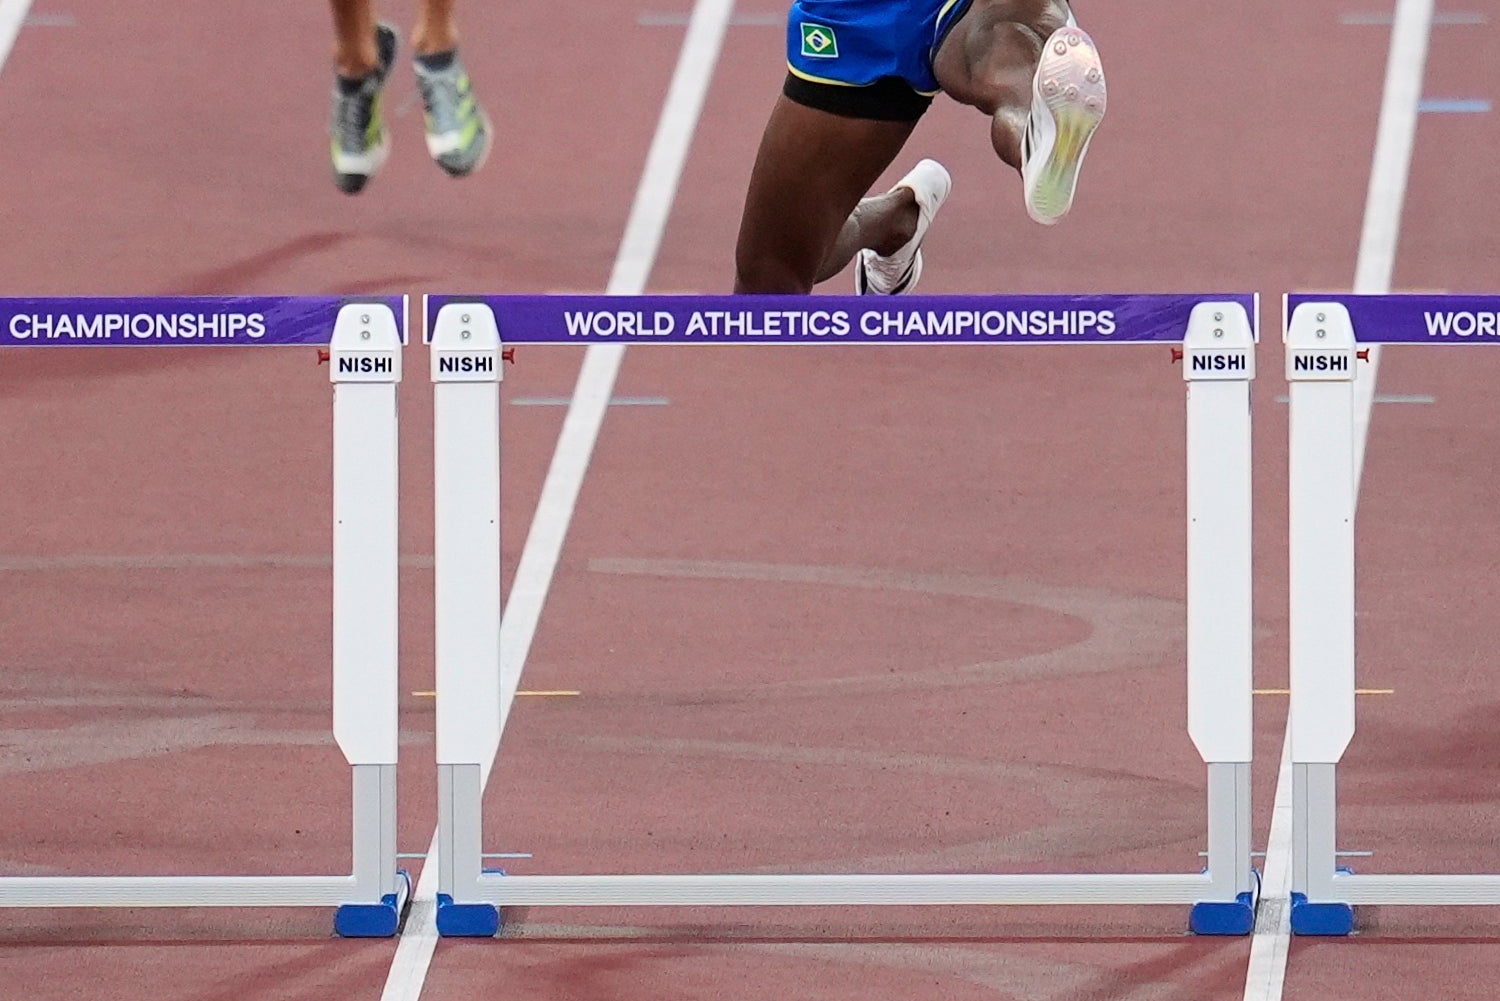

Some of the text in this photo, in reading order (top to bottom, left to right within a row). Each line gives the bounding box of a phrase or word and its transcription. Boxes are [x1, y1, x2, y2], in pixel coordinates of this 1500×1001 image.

[9, 313, 266, 339] CHAMPIONSHIPS
[564, 310, 1116, 336] WORLD ATHLETICS CHAMPIONSHIPS
[339, 357, 392, 373] NISHI
[439, 356, 493, 372] NISHI
[1192, 354, 1246, 371] NISHI
[1294, 355, 1348, 371] NISHI
